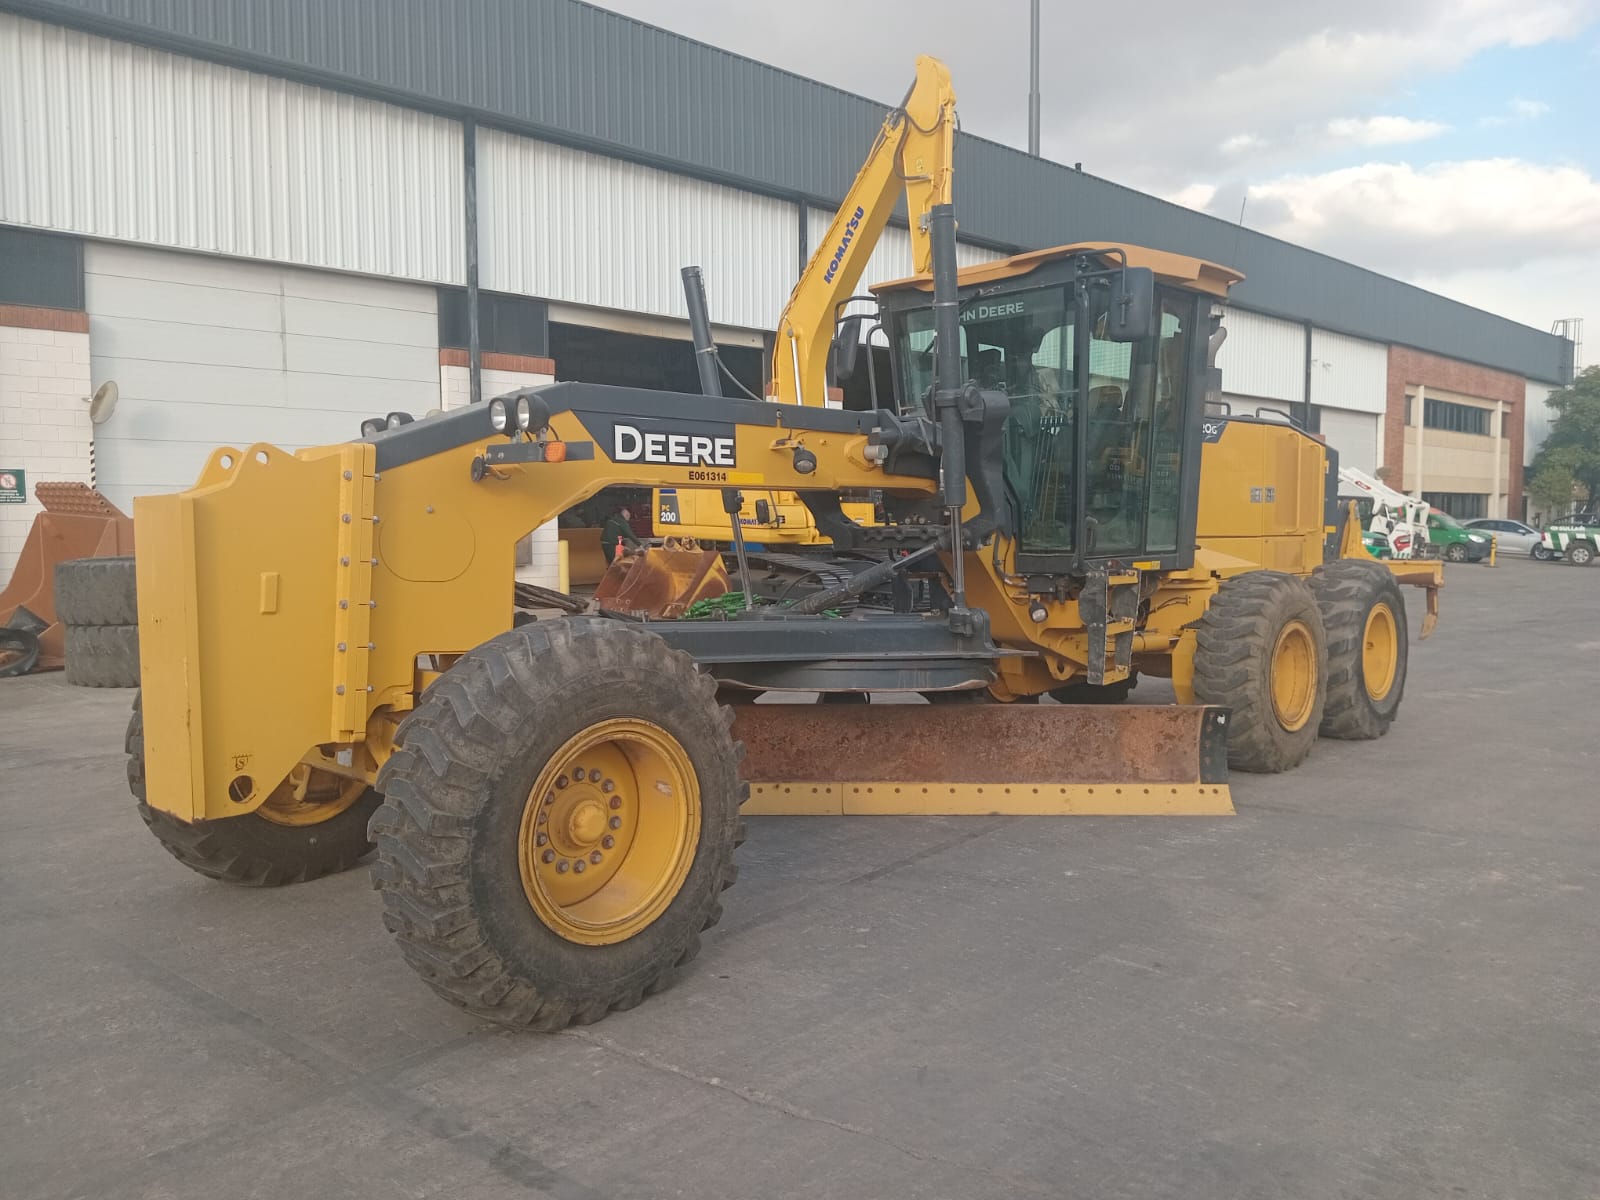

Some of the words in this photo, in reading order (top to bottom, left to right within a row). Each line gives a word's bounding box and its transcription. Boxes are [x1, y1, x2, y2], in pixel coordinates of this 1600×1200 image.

[824, 206, 864, 284] KOMATSU
[959, 310, 976, 322] HN
[979, 302, 1024, 319] DEERE
[614, 424, 735, 466] DEERE
[688, 471, 727, 481] E061314
[660, 511, 676, 522] 200
